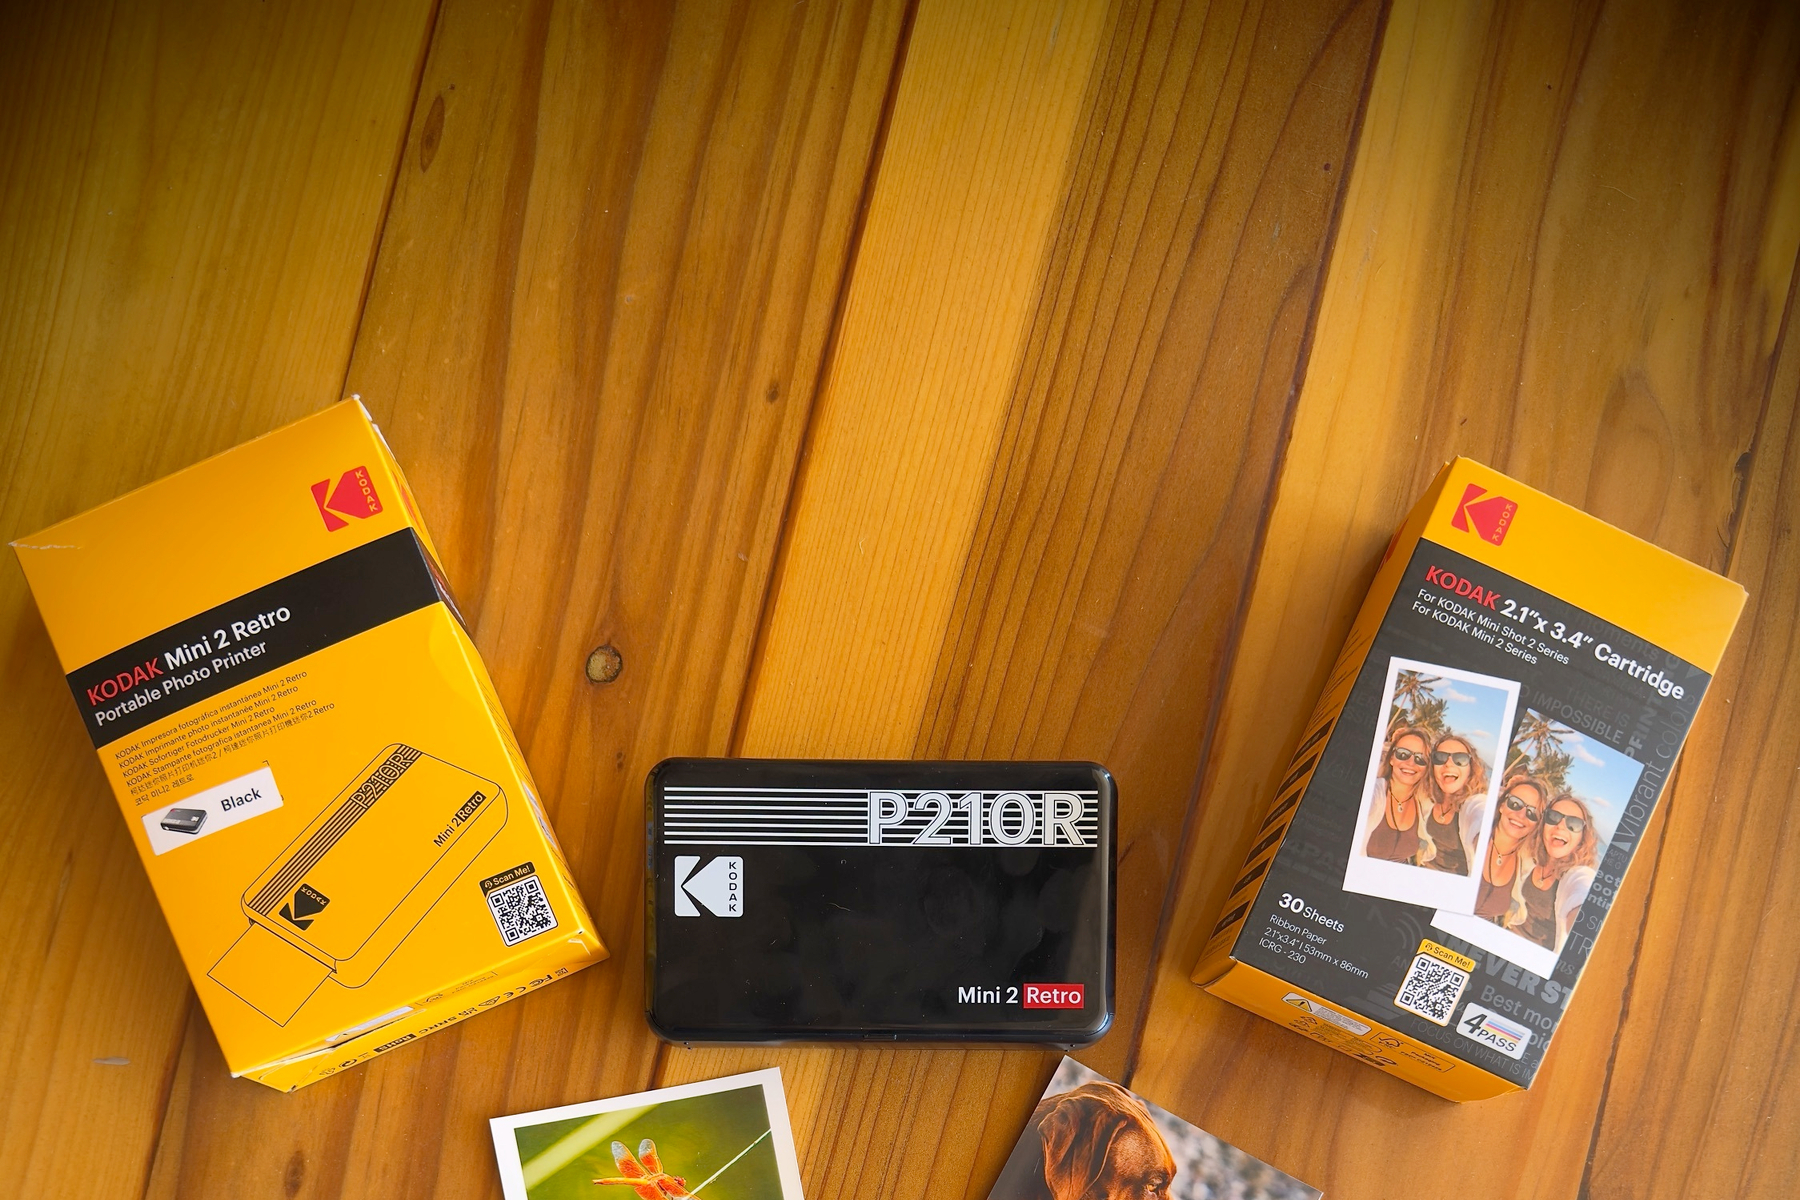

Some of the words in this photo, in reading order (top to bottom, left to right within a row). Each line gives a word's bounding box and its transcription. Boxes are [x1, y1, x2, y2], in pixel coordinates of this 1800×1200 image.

[355, 470, 378, 512] KODAK
[1491, 503, 1513, 542] KODAK
[1411, 601, 1431, 617] For
[1431, 609, 1471, 634] KODAK
[1471, 627, 1495, 645] Mini
[1495, 638, 1504, 650] 2
[1503, 642, 1538, 665] Series
[1416, 588, 1436, 605] For
[1436, 597, 1476, 622] KODAK
[1476, 614, 1501, 633] Mini
[1500, 625, 1528, 646] Shot
[1527, 638, 1536, 649] 2
[1536, 642, 1570, 665] Series
[1425, 565, 1502, 611] KODAK
[1592, 641, 1685, 701] Cartridge
[86, 657, 164, 706] KODAK
[162, 635, 212, 670] Mini
[211, 627, 231, 649] 2
[229, 604, 292, 641] Retro
[94, 685, 162, 726] Portable
[161, 665, 212, 695] Photo
[210, 641, 268, 674] Printer
[312, 701, 335, 715] Retro
[114, 743, 140, 760] KODAK
[140, 726, 178, 748] Impresora
[177, 708, 218, 731] fotográfica
[218, 689, 262, 712] instantánea
[262, 681, 279, 694] Mini
[285, 670, 307, 683] Retro
[118, 751, 144, 769] KODAK
[144, 733, 187, 757] Imprimante
[186, 722, 210, 738] photo
[253, 695, 270, 708] Mini
[276, 684, 298, 698] Retro
[1531, 690, 1624, 745] IMPOSSIBLE
[122, 761, 148, 778] KODAK
[148, 745, 185, 766] Sofortiger
[185, 725, 230, 749] Fotodrucker
[230, 716, 247, 728] Mini
[253, 705, 275, 719] Retro
[126, 770, 152, 787] KODAK
[151, 752, 192, 775] Stampante
[192, 734, 233, 757] fotografica
[232, 717, 272, 739] istantanea
[272, 709, 289, 722] Mini
[295, 698, 317, 712] Retro
[220, 788, 262, 812] Black
[351, 752, 414, 810] P210R
[433, 824, 455, 847] Mini
[451, 817, 462, 828] 2
[457, 794, 484, 823] Retro
[868, 791, 1087, 846] P210R
[300, 886, 327, 906] KODAK
[493, 872, 514, 885] Scan
[514, 865, 531, 877] Me!
[728, 861, 738, 912] KODAK
[1269, 914, 1301, 934] Ribbon
[1300, 927, 1327, 946] Paper
[1277, 891, 1306, 915] 30
[1302, 905, 1345, 933] Sheets
[1258, 937, 1283, 954] ICRG
[1287, 950, 1307, 965] 230
[1303, 944, 1333, 964] 53mm
[1332, 958, 1339, 966] x
[1338, 960, 1369, 980] 86mm
[1433, 946, 1454, 961] Scan
[1454, 956, 1471, 969] Me!
[958, 985, 1001, 1004] Mini
[1005, 986, 1019, 1004] 2
[1027, 986, 1082, 1004] Retro
[1480, 984, 1523, 1017] Best
[1410, 1018, 1452, 1045] FOCUS
[1452, 1037, 1473, 1054] ON
[1472, 1046, 1508, 1070] WHAT
[1508, 1062, 1521, 1076] IS
